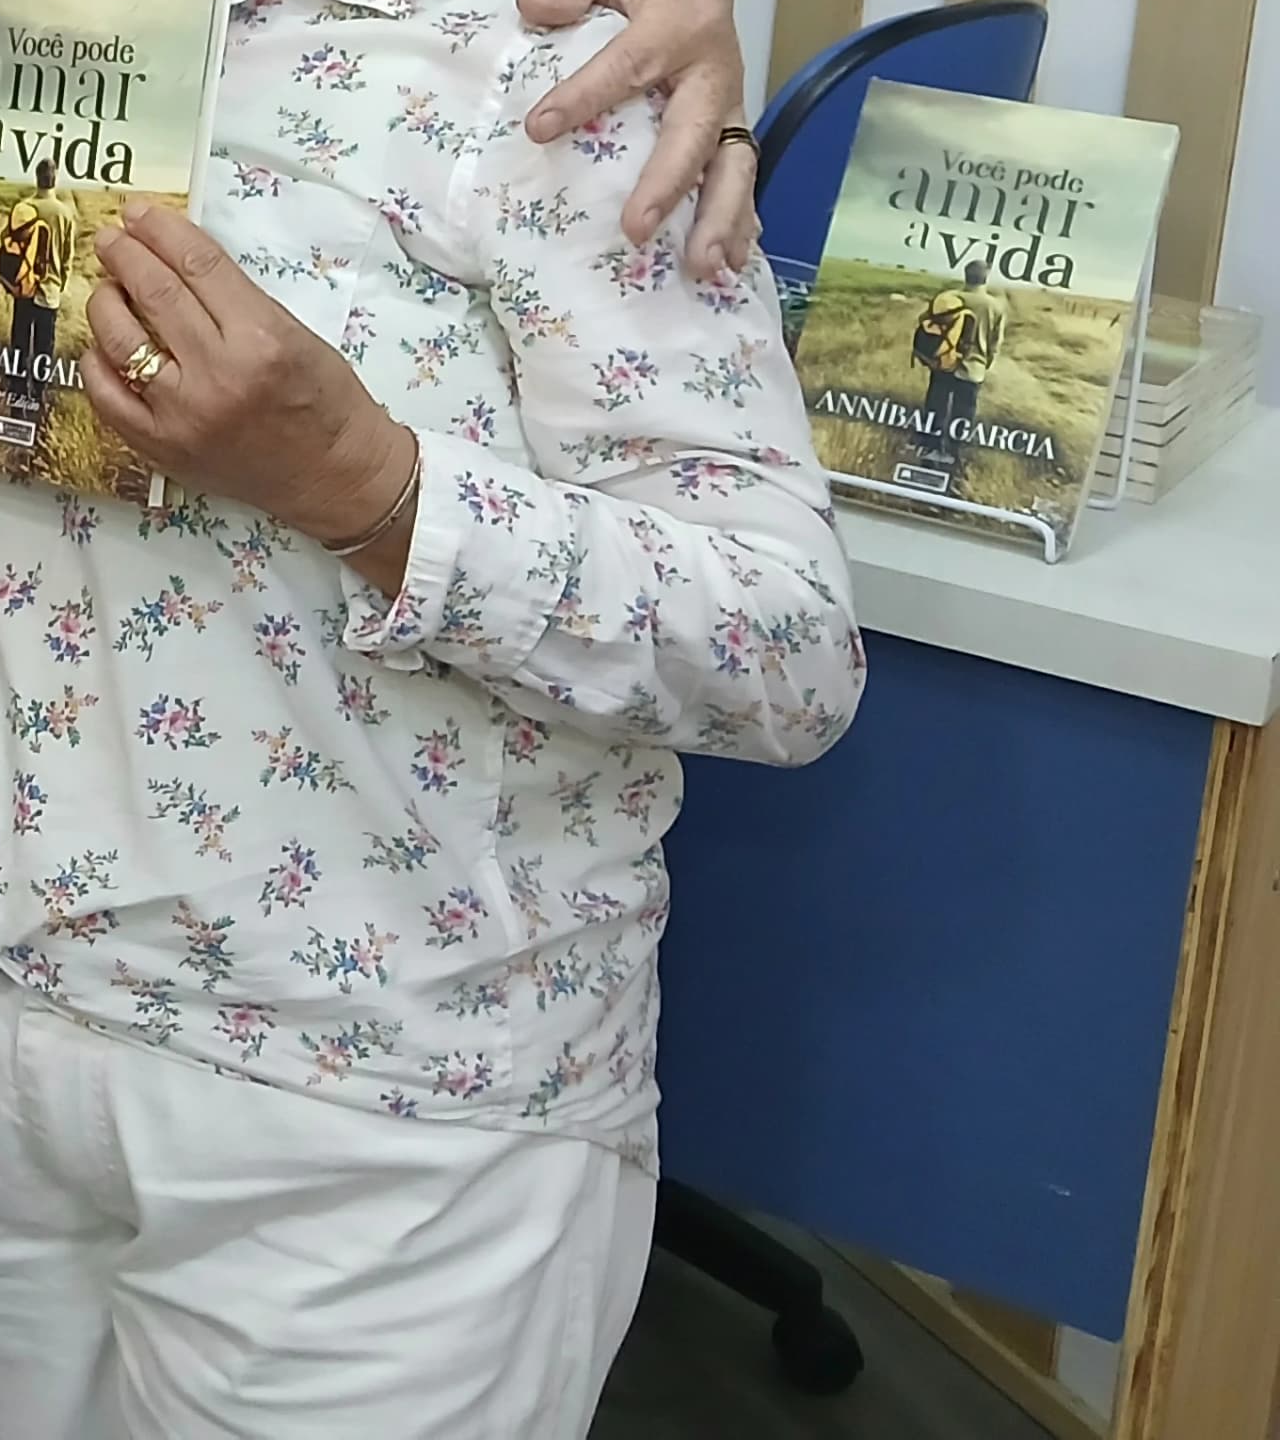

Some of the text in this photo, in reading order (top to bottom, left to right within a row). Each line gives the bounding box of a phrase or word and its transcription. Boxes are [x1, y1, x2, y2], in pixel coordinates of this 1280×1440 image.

[8, 26, 135, 68] Você pode
[10, 119, 134, 186] vida
[942, 148, 1085, 194] Você pode
[888, 166, 1096, 239] amar
[904, 220, 1075, 290] a vida
[815, 390, 942, 436] ANNÍBAL
[949, 417, 1056, 460] GARCIA
